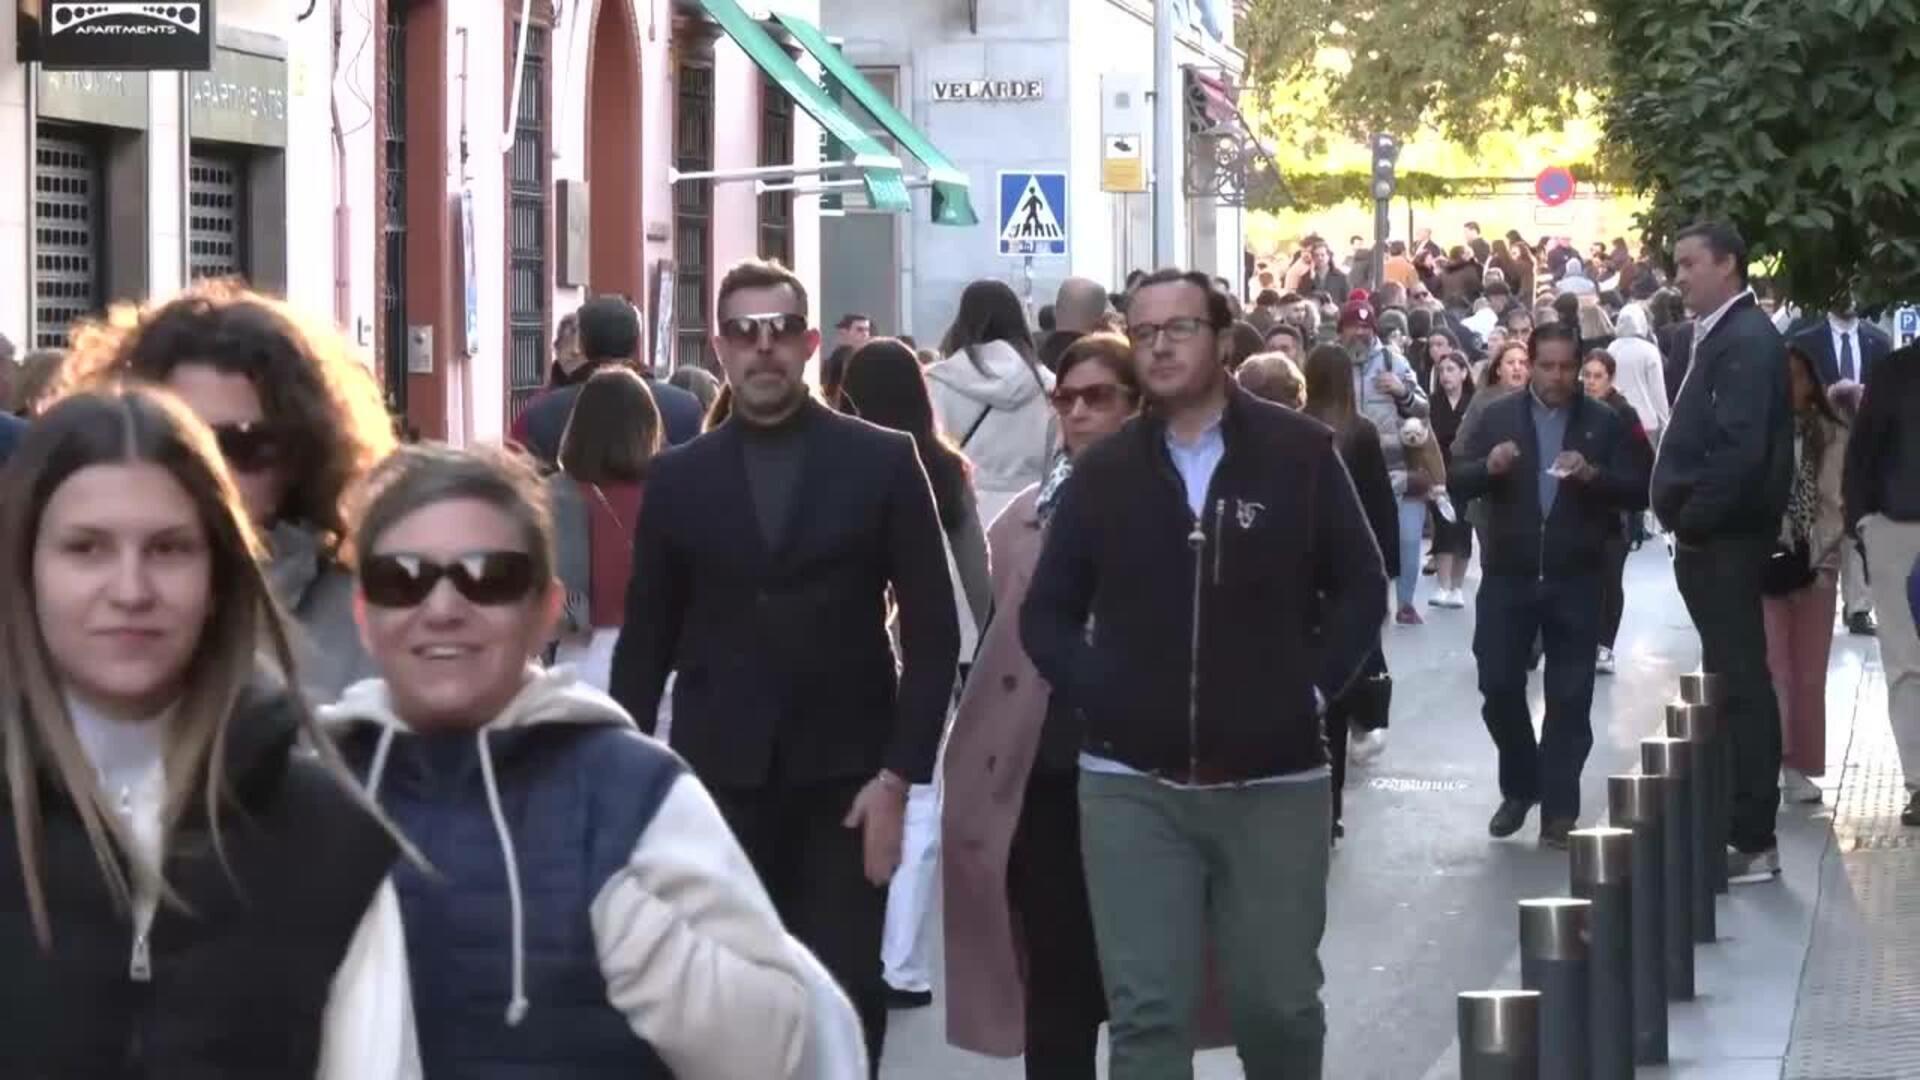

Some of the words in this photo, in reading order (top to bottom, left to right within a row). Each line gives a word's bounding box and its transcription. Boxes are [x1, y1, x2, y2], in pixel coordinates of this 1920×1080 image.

[75, 24, 177, 35] APARTMENTS
[934, 81, 1041, 98] VELARDE
[1903, 314, 1914, 329] P
